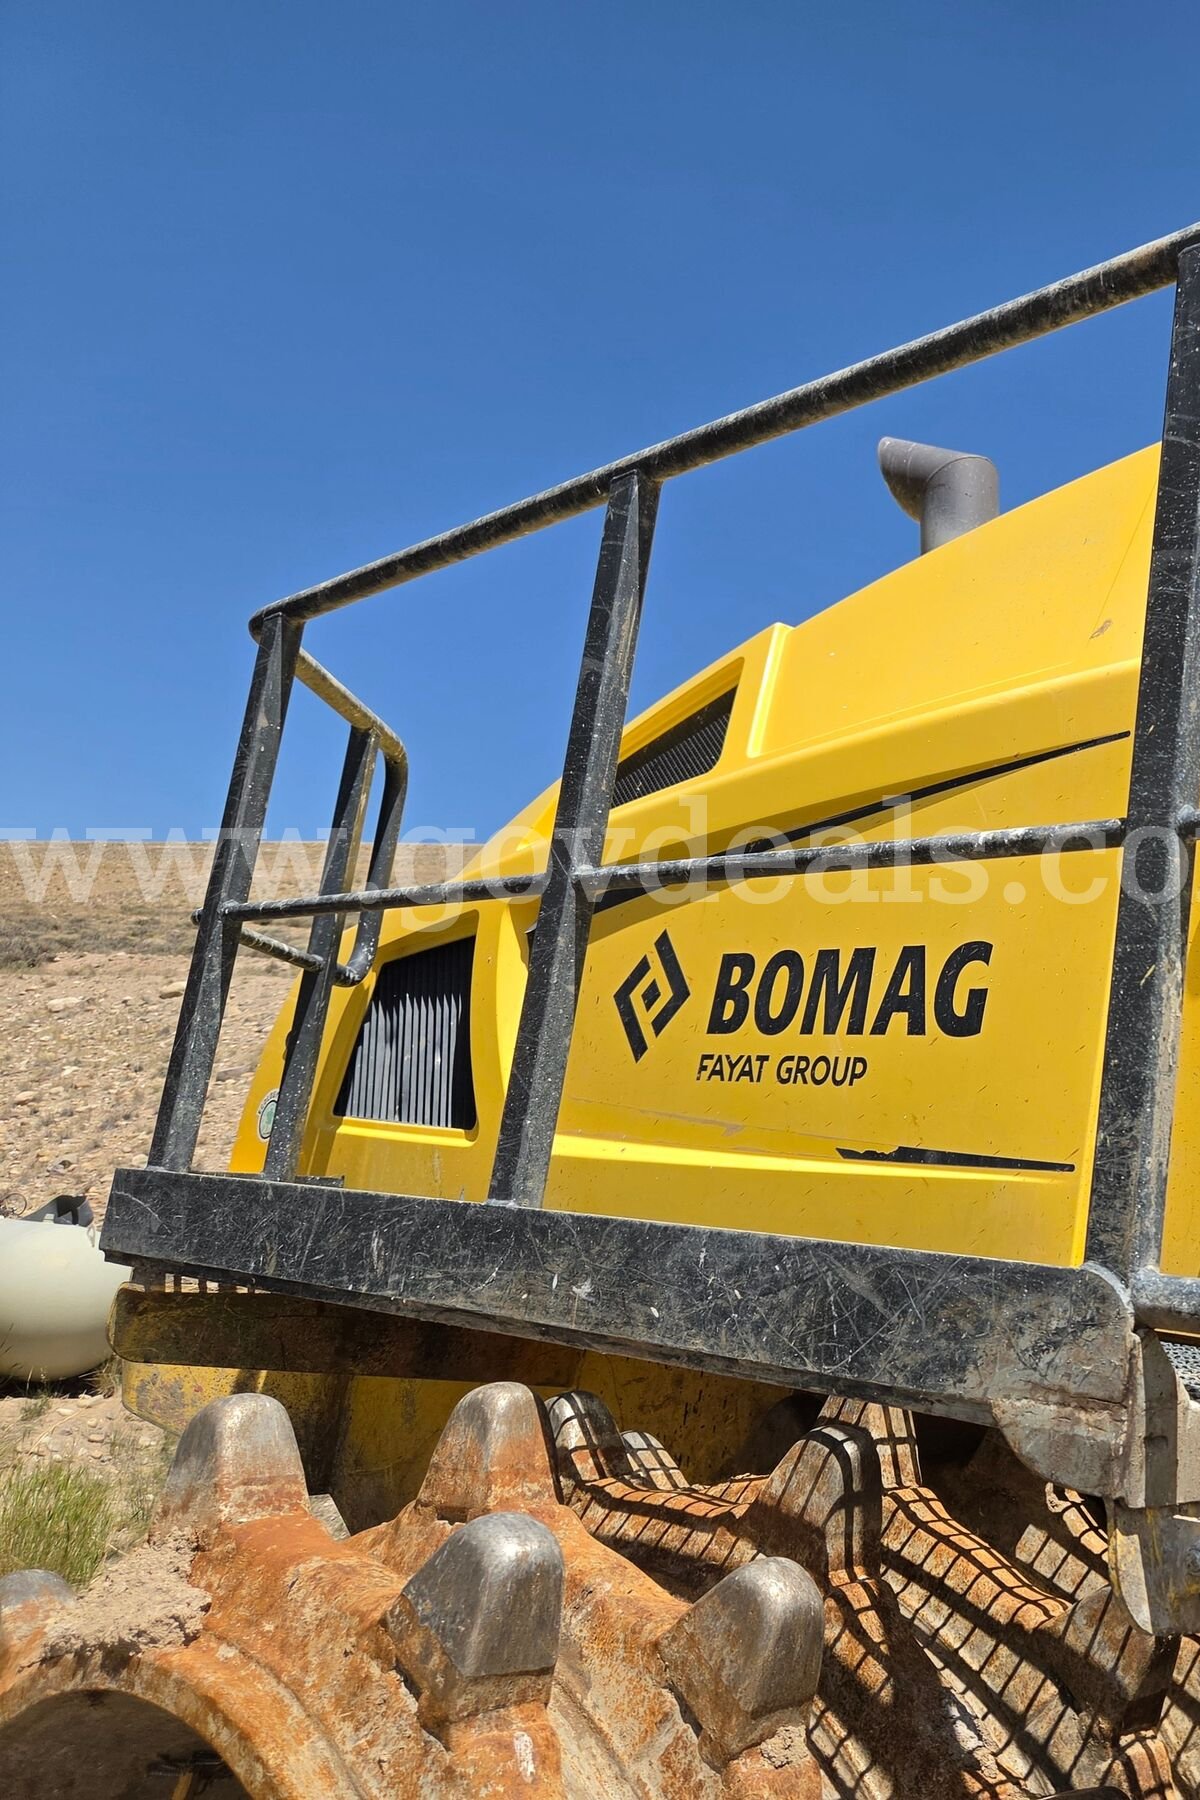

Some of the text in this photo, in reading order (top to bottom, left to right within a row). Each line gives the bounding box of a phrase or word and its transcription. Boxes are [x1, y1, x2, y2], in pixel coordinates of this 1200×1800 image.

[706, 940, 993, 1037] BOMAG
[696, 1054, 868, 1086] FAYAT GROUP
